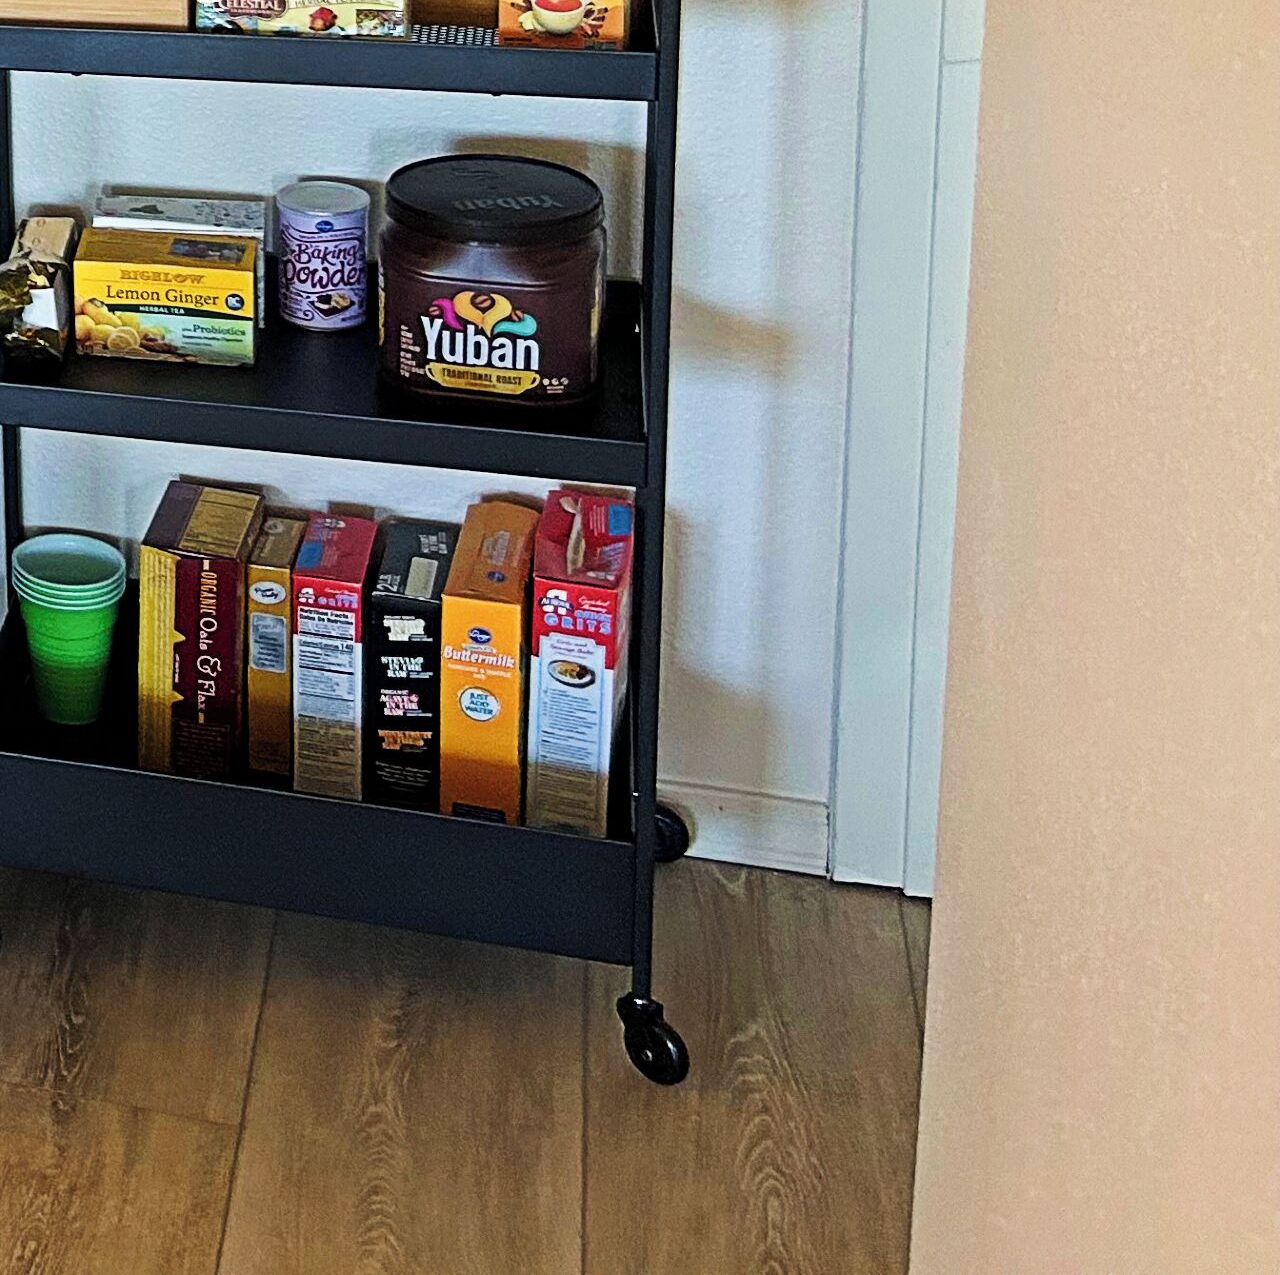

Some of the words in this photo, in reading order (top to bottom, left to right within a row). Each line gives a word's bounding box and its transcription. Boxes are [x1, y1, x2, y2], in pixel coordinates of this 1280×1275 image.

[292, 243, 358, 266] Baking
[120, 269, 206, 285] BIGELOW
[106, 285, 160, 301] Lemon
[165, 289, 220, 307] Ginger
[171, 307, 185, 315] TEA
[193, 324, 246, 336] Probiotics
[420, 315, 540, 371] Yuban
[442, 367, 494, 383] TRADITIONAL
[496, 374, 522, 387] ROAST
[199, 571, 217, 615] ORGANIC
[544, 612, 612, 635] GRITS
[196, 655, 222, 677] &
[443, 645, 515, 668] Buttermilk
[197, 679, 216, 710] Flax
[464, 705, 494, 715] WATER
